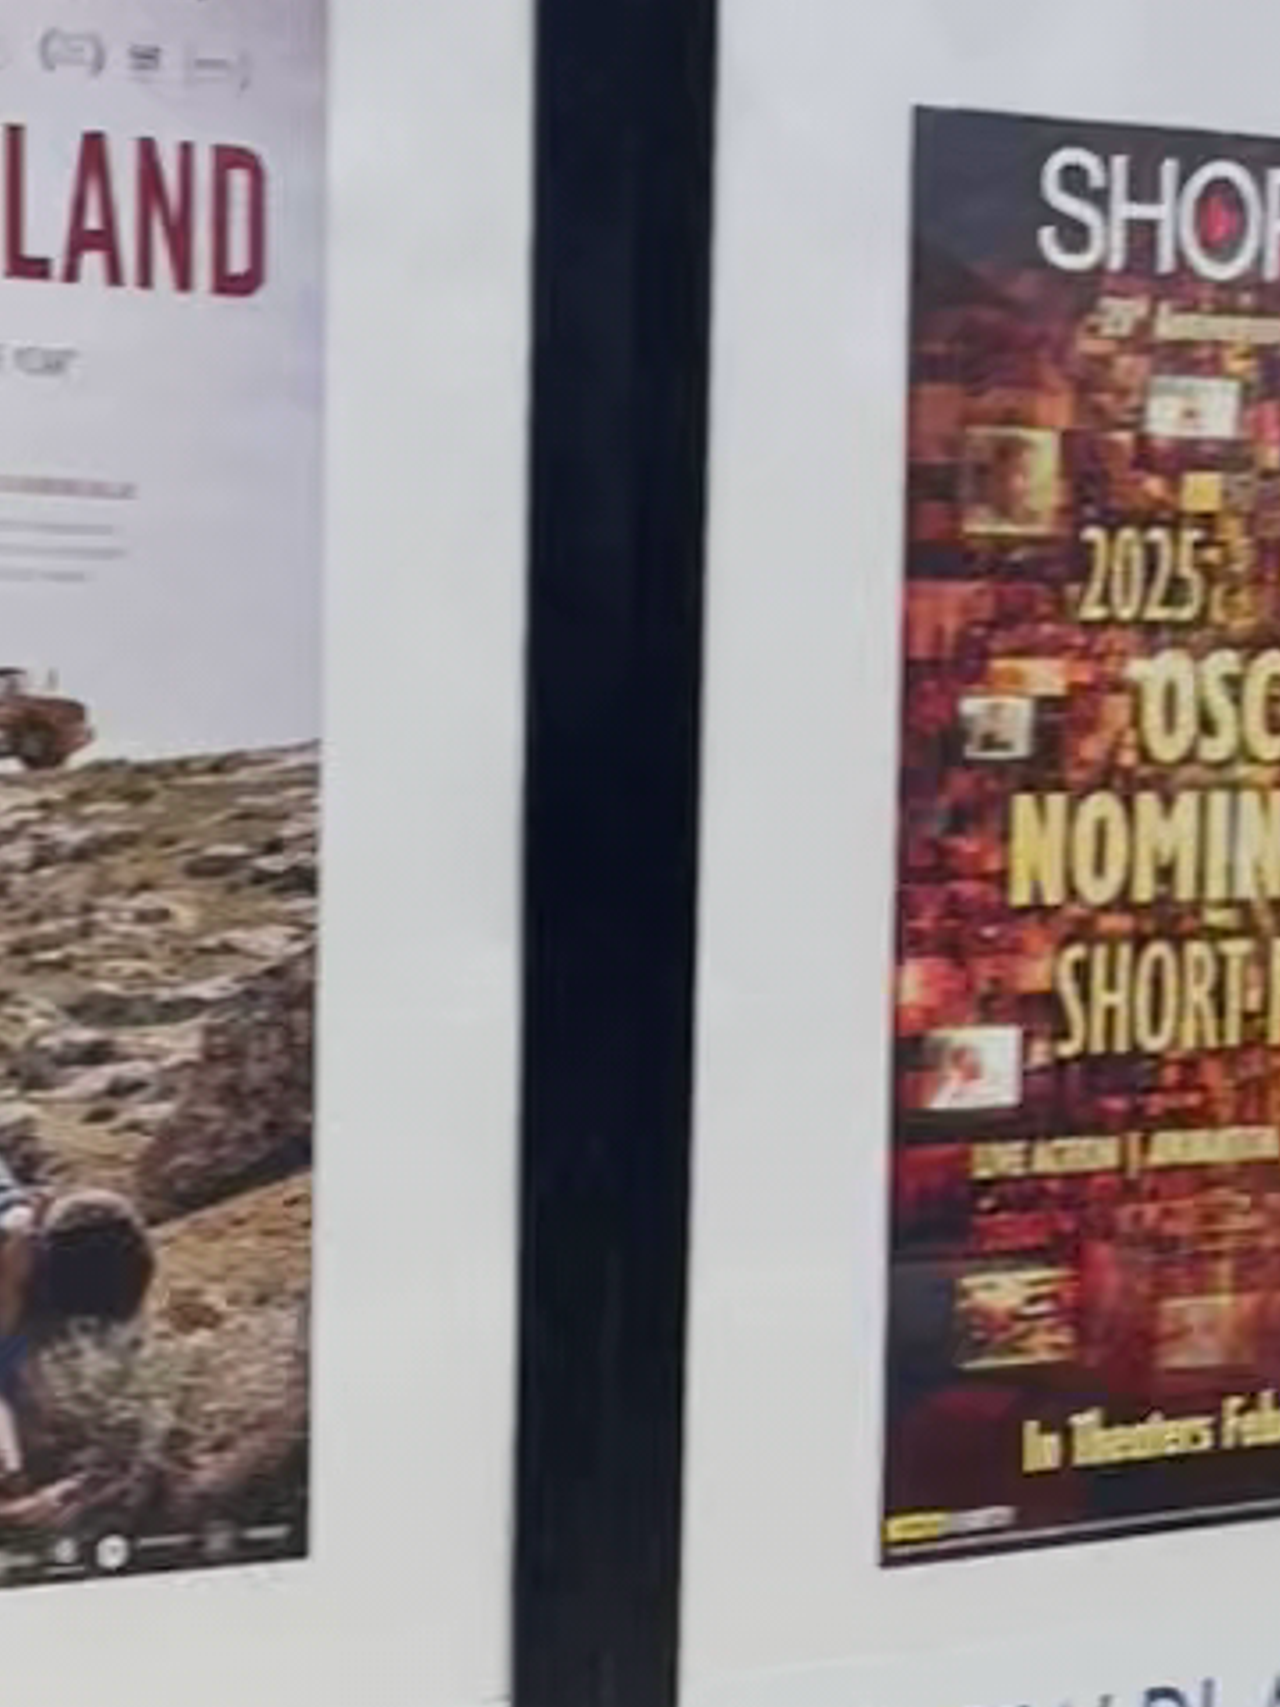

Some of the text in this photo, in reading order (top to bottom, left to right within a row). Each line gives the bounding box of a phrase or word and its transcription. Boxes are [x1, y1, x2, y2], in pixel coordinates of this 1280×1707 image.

[2, 123, 267, 298] LAND
[1079, 526, 1205, 621] 2025
[1056, 936, 1244, 1060] SHORT
